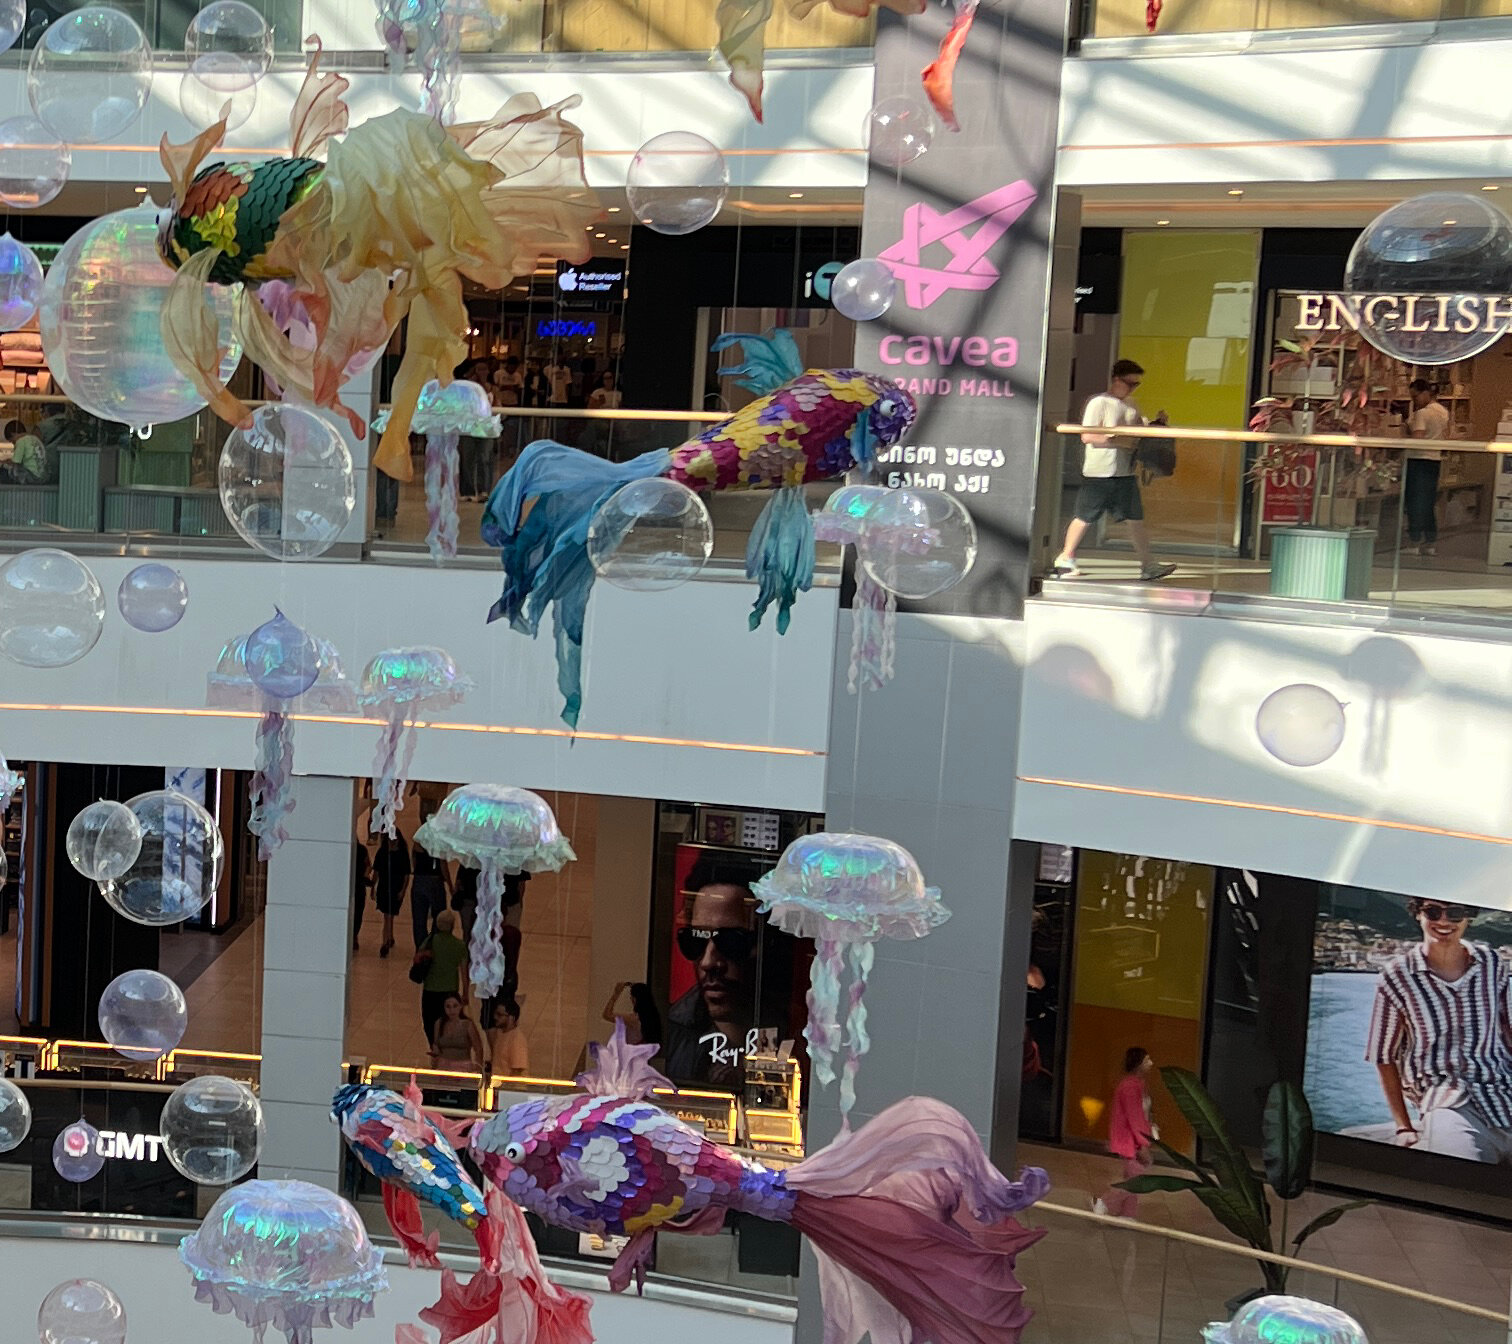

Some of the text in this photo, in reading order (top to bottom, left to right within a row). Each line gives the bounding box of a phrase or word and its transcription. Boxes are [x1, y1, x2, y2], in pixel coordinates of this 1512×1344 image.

[879, 334, 1019, 368] cavea
[894, 377, 1015, 397] RAND MALL
[945, 447, 1005, 467] უნდა
[954, 474, 990, 494] აქ!
[699, 1028, 759, 1067] Ray-B
[96, 1130, 163, 1162] GMT
